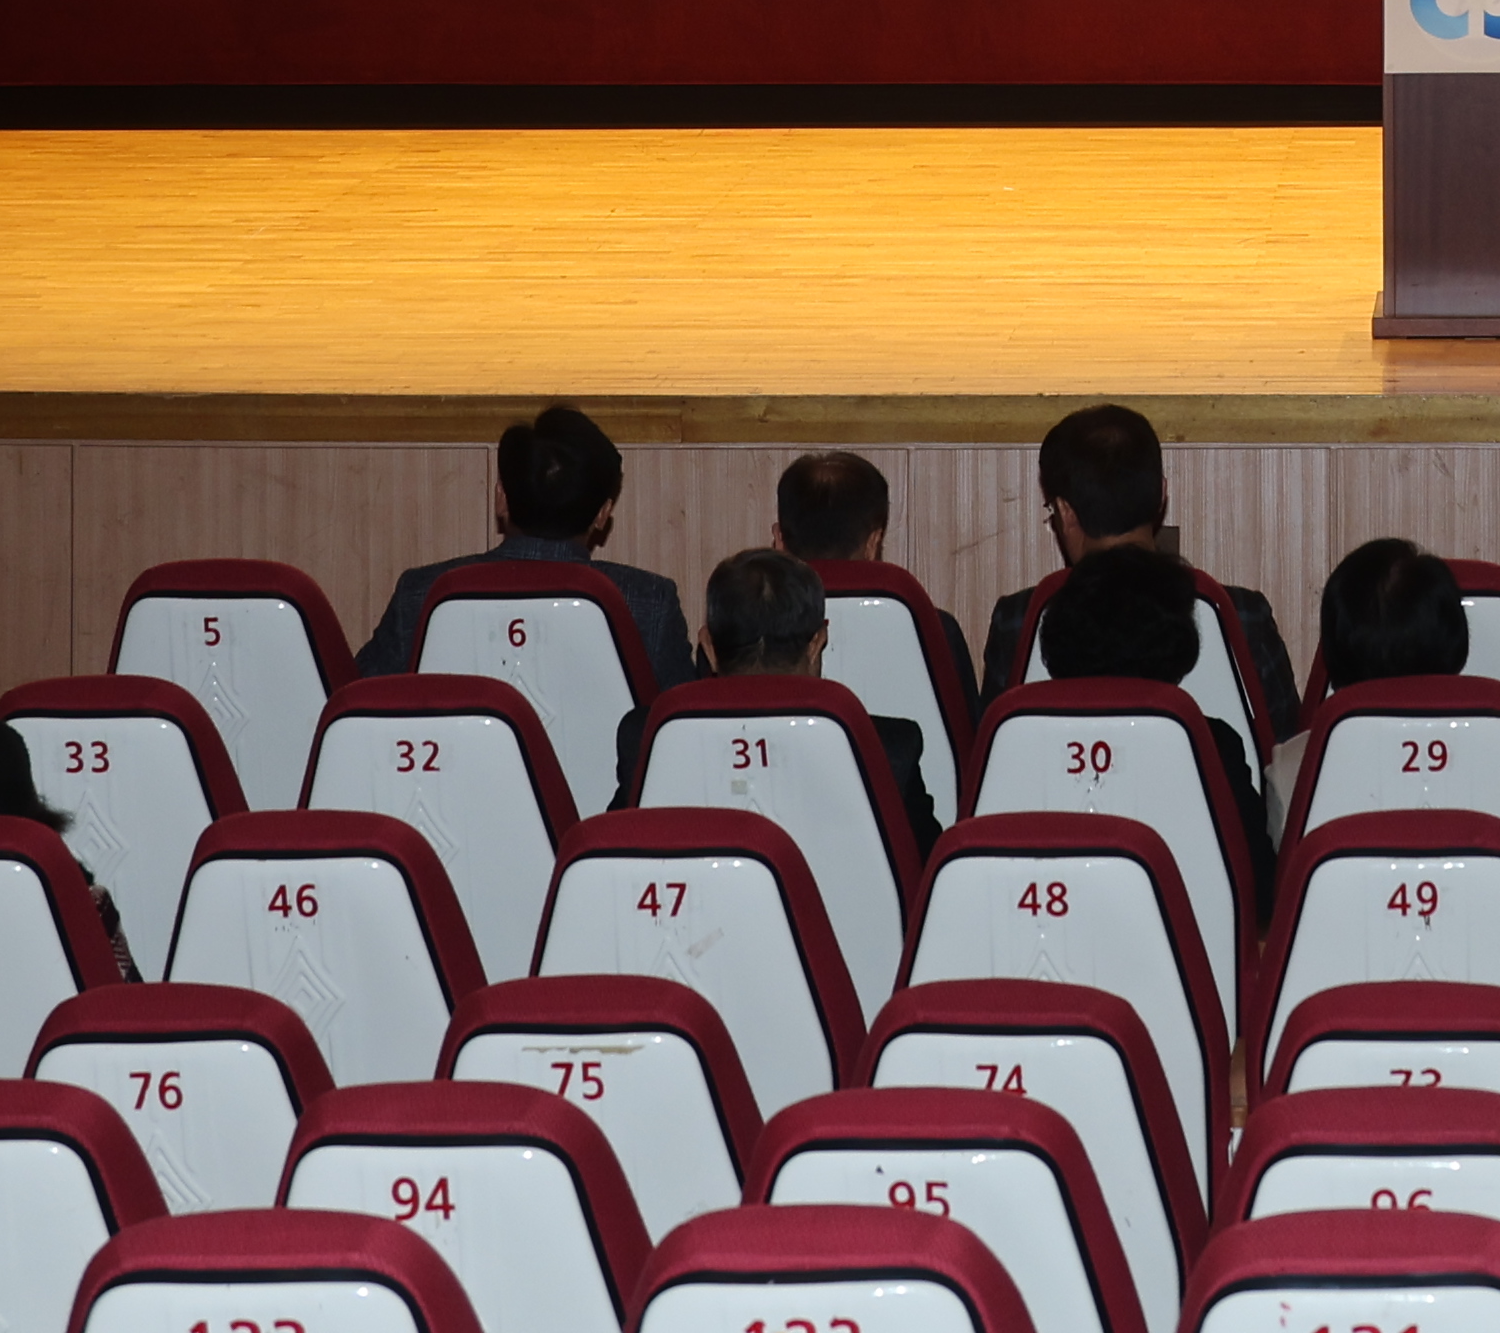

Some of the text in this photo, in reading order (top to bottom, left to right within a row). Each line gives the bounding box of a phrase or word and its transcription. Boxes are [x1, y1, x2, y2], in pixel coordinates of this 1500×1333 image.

[204, 617, 221, 646] 5
[509, 619, 526, 647] 6
[66, 741, 109, 773] 33
[397, 741, 438, 773] 32
[733, 738, 768, 769] 31
[1069, 741, 1111, 774] 30
[1403, 740, 1448, 772] 29
[269, 884, 317, 917] 46
[638, 883, 686, 916] 47
[1019, 882, 1068, 917] 48
[1389, 882, 1438, 916] 49
[131, 1072, 182, 1110] 76
[550, 1062, 604, 1101] 75
[391, 1177, 456, 1221] 94
